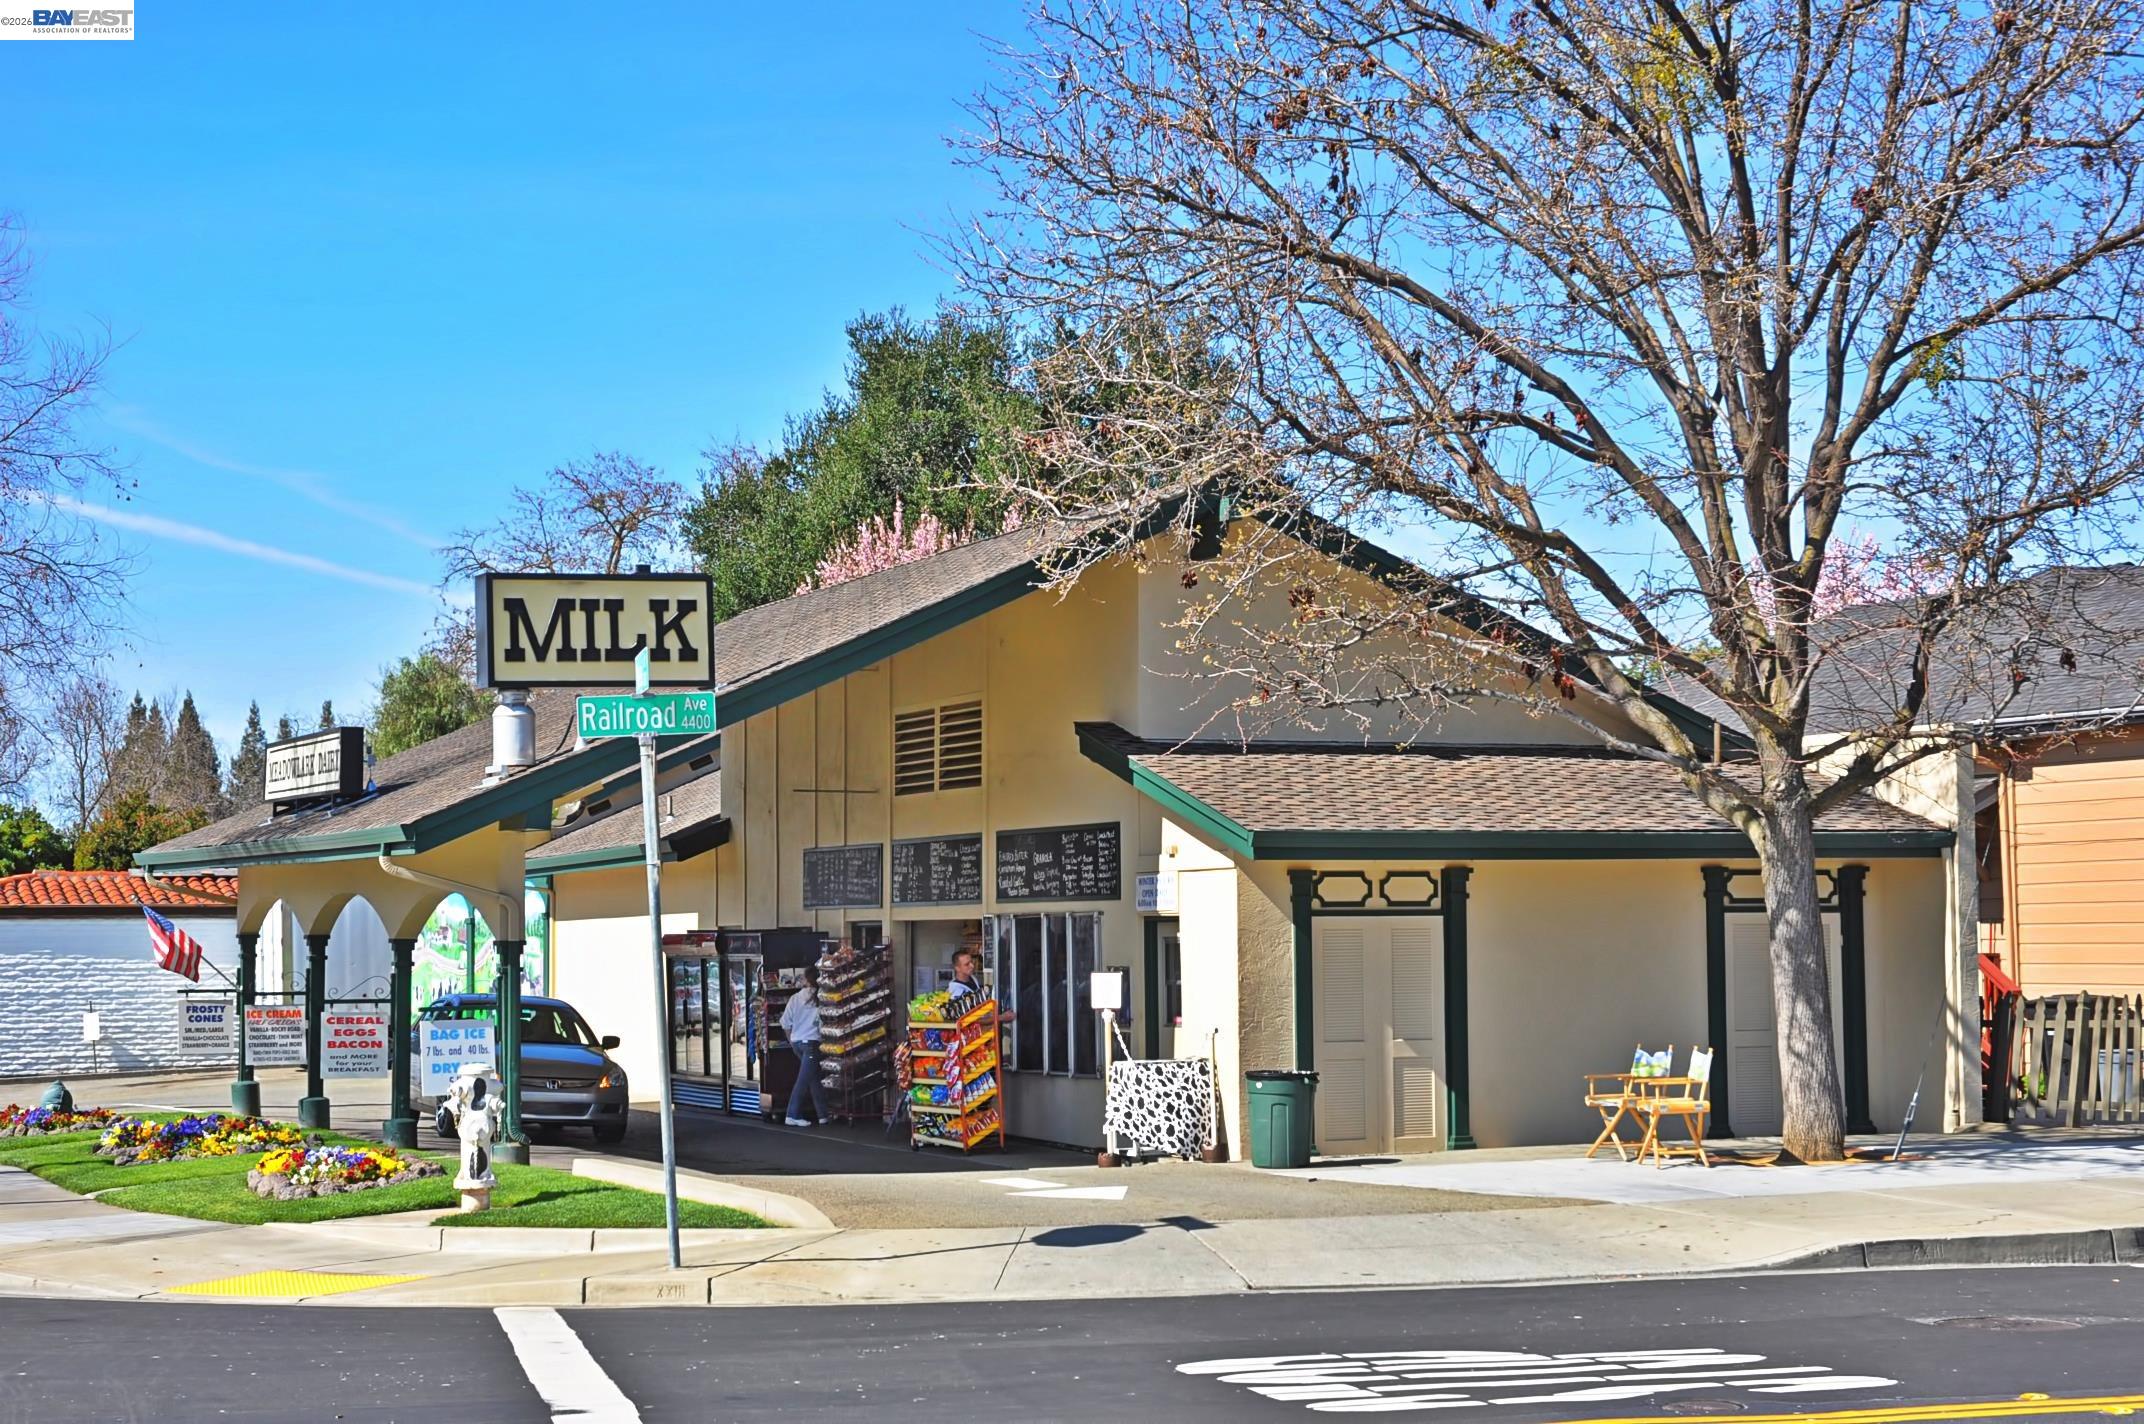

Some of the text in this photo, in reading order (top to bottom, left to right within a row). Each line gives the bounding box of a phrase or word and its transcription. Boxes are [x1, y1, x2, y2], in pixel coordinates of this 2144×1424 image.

[503, 598, 698, 661] MILK
[684, 696, 708, 711] Ave
[581, 702, 676, 732] Railroad
[681, 714, 711, 729] 4400
[186, 1005, 226, 1014] FROSTY
[246, 1009, 302, 1018] ICE CREAM
[188, 1015, 224, 1023] CONES
[326, 1017, 384, 1025] CEREAL
[334, 1029, 376, 1037] EGGS
[430, 1028, 486, 1041] BAG ICE
[327, 1041, 382, 1049] BACON
[426, 1044, 490, 1057] 7 lbs. and 40 lbs.
[432, 1062, 460, 1074] DRY
[1175, 1347, 1899, 1412] STOP
